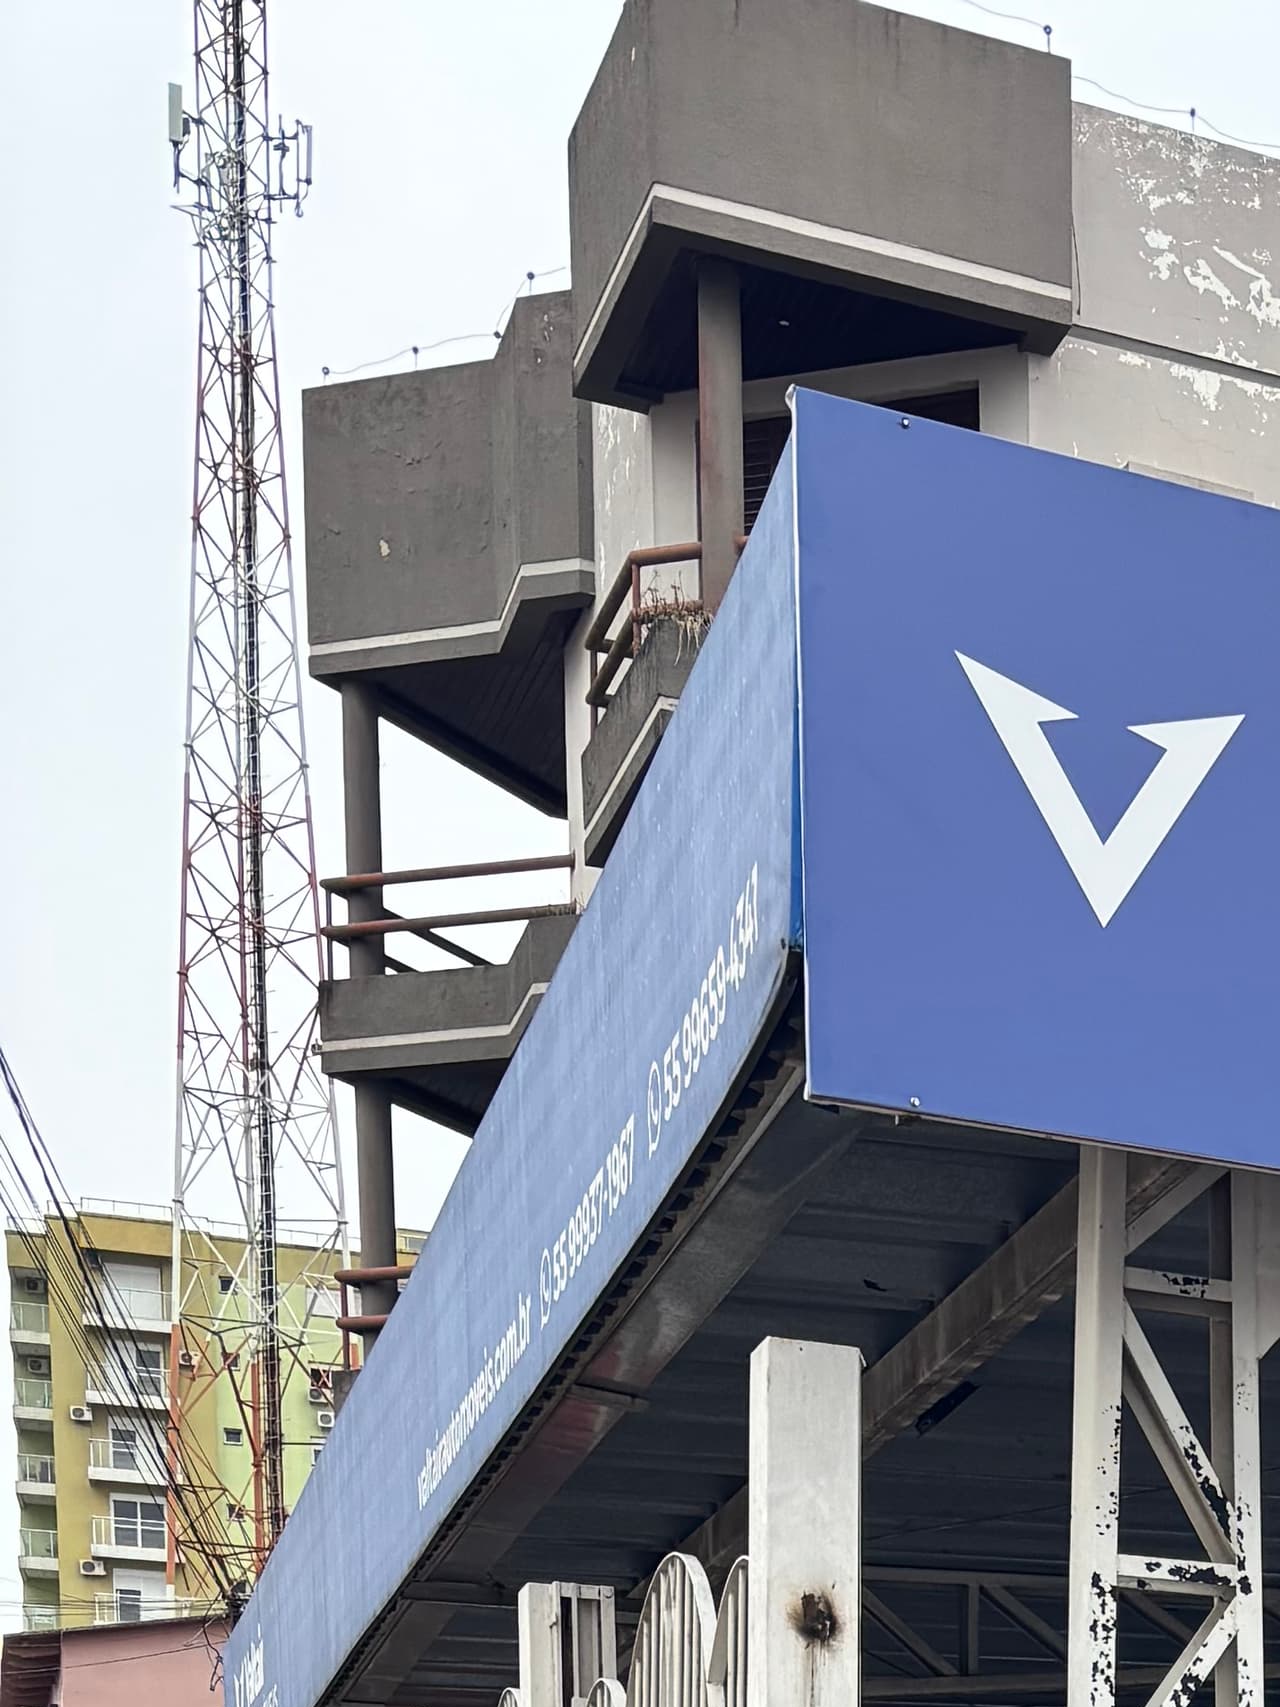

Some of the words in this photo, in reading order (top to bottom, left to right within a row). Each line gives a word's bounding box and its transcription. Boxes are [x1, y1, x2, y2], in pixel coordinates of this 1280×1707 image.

[663, 1031, 682, 1121] 55
[553, 1229, 568, 1303] 55
[569, 1113, 635, 1278] 99937-1967
[417, 1292, 532, 1511] valtairautomoveis.com.br
